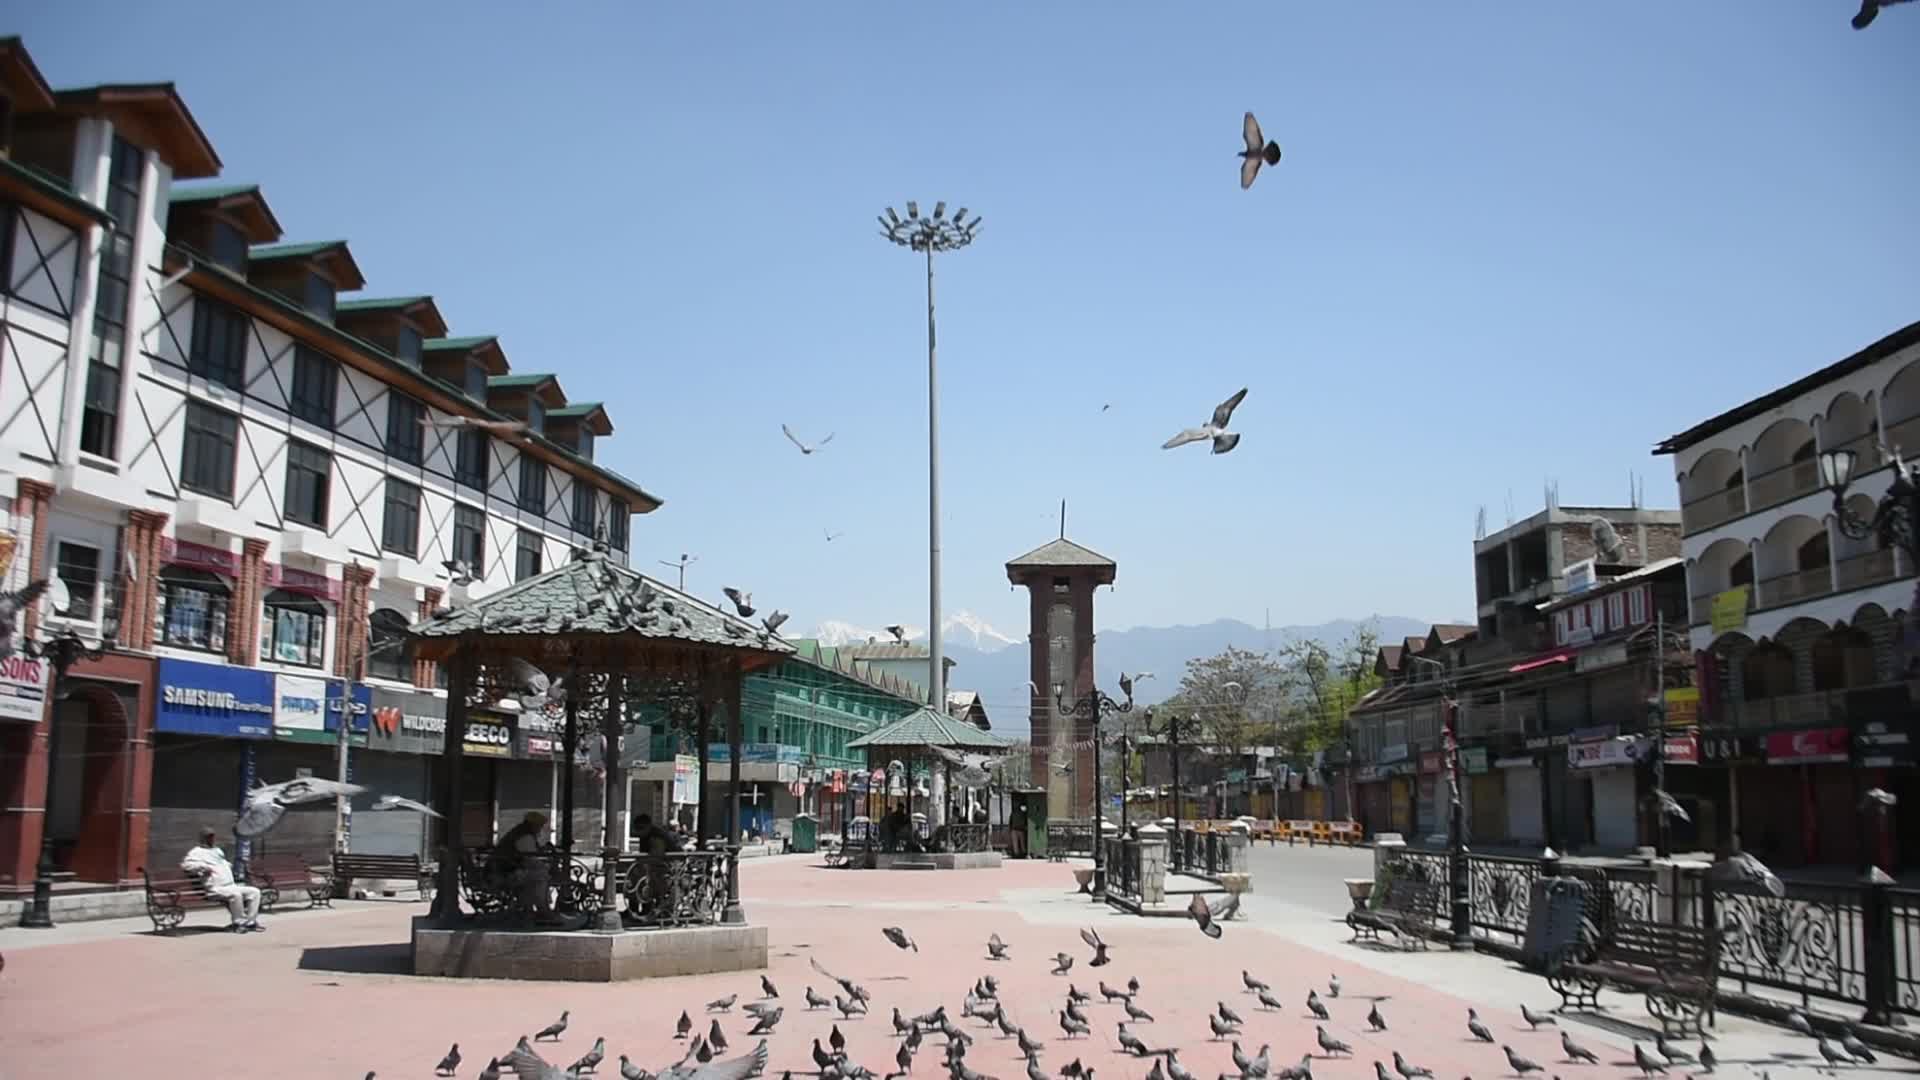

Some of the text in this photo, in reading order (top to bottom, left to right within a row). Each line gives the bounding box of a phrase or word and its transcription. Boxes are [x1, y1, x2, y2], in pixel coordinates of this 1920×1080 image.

[0, 656, 41, 683] SONS
[164, 685, 235, 709] SAMSUNG
[402, 713, 447, 733] WILDCRAF
